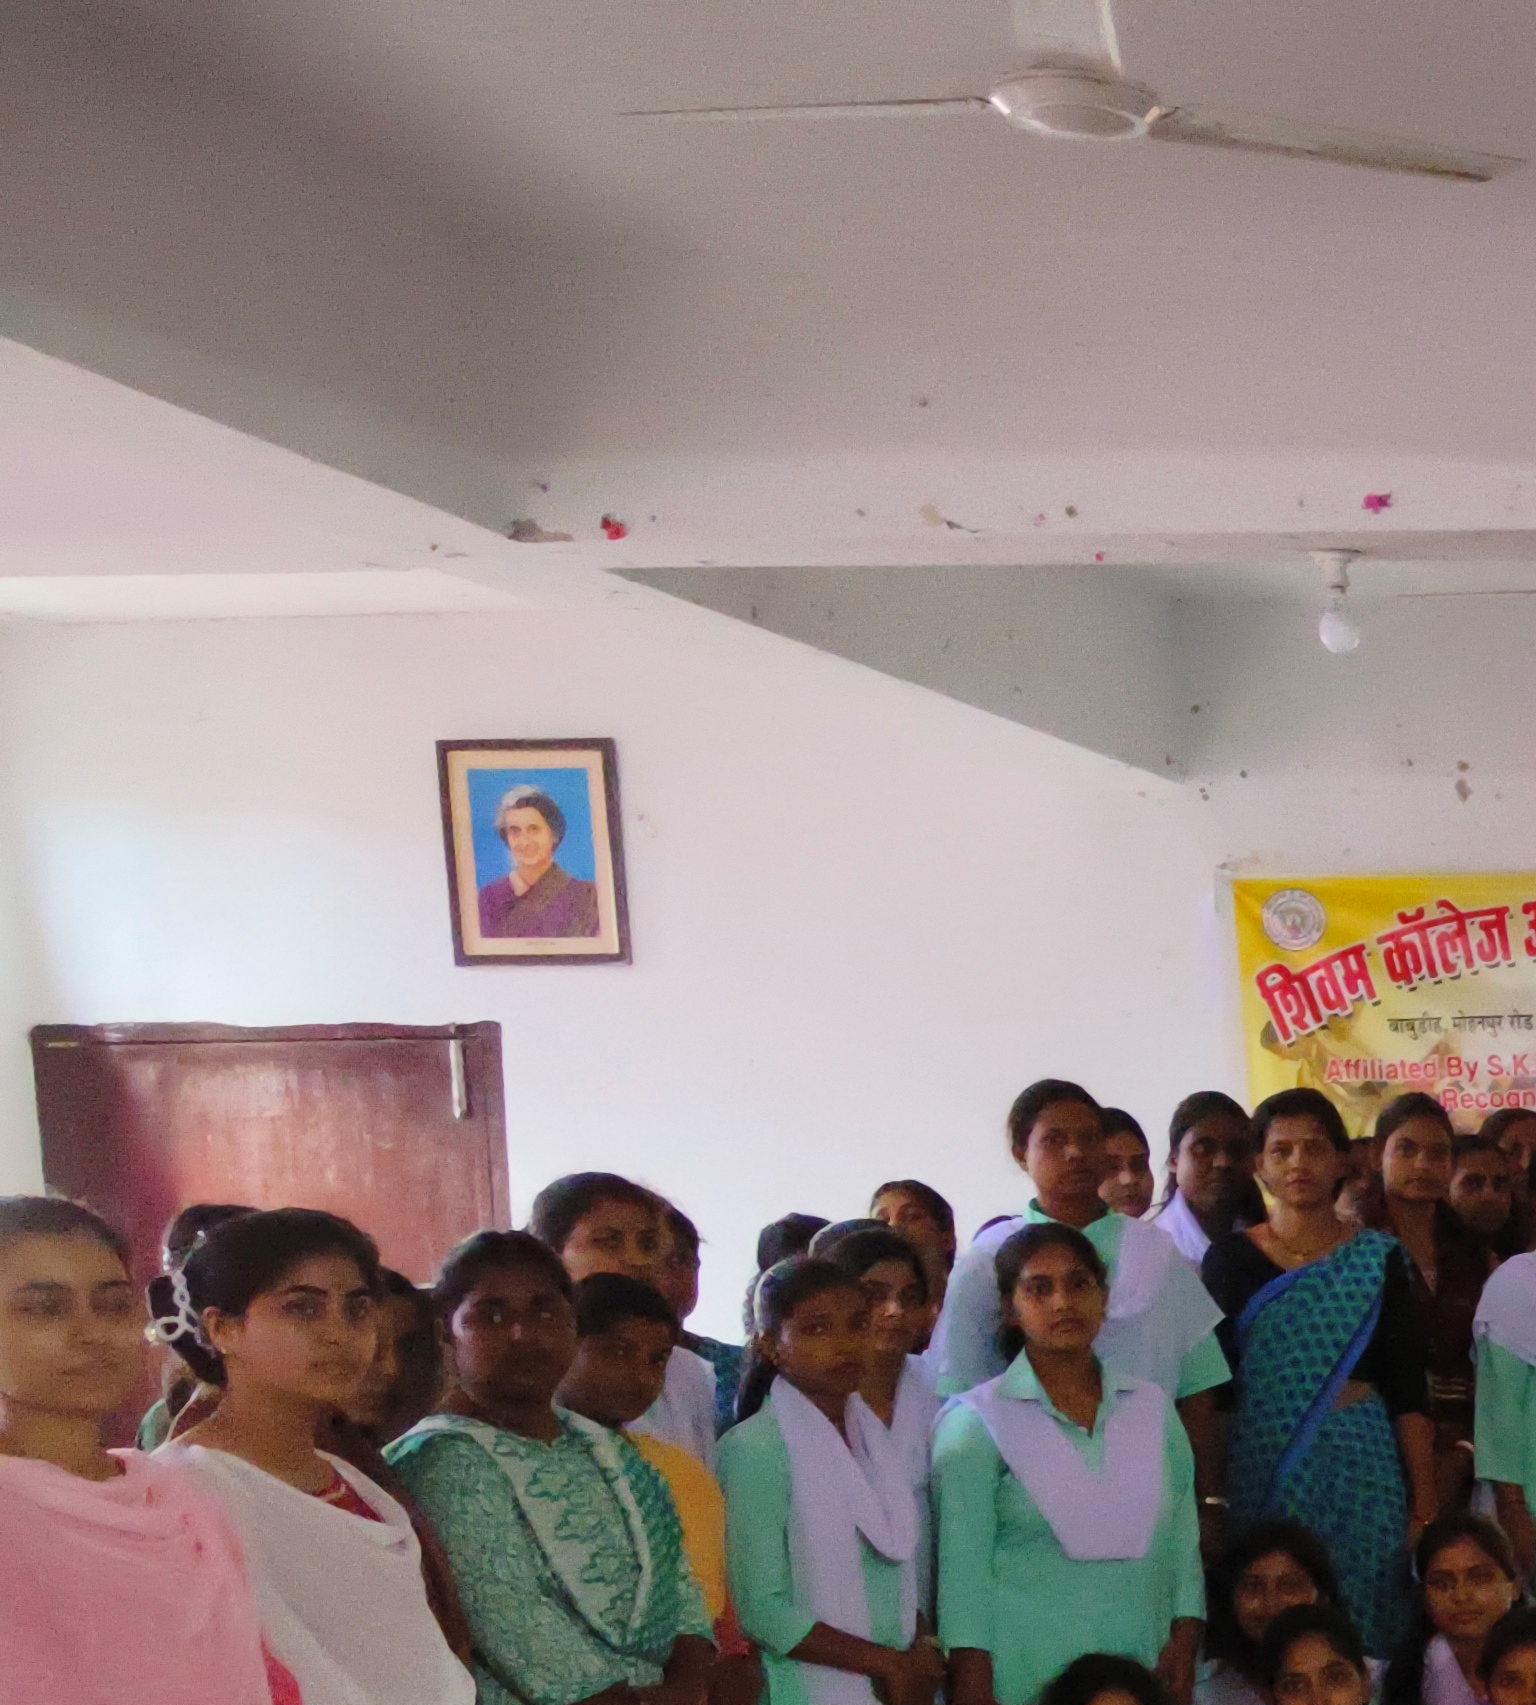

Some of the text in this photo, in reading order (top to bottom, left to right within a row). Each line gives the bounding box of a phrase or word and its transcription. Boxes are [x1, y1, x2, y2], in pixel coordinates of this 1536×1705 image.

[1256, 943, 1377, 1041] शिवम
[1376, 899, 1511, 984] कॉलेज
[1326, 1055, 1437, 1081] Affiliated
[1447, 1056, 1478, 1082] By
